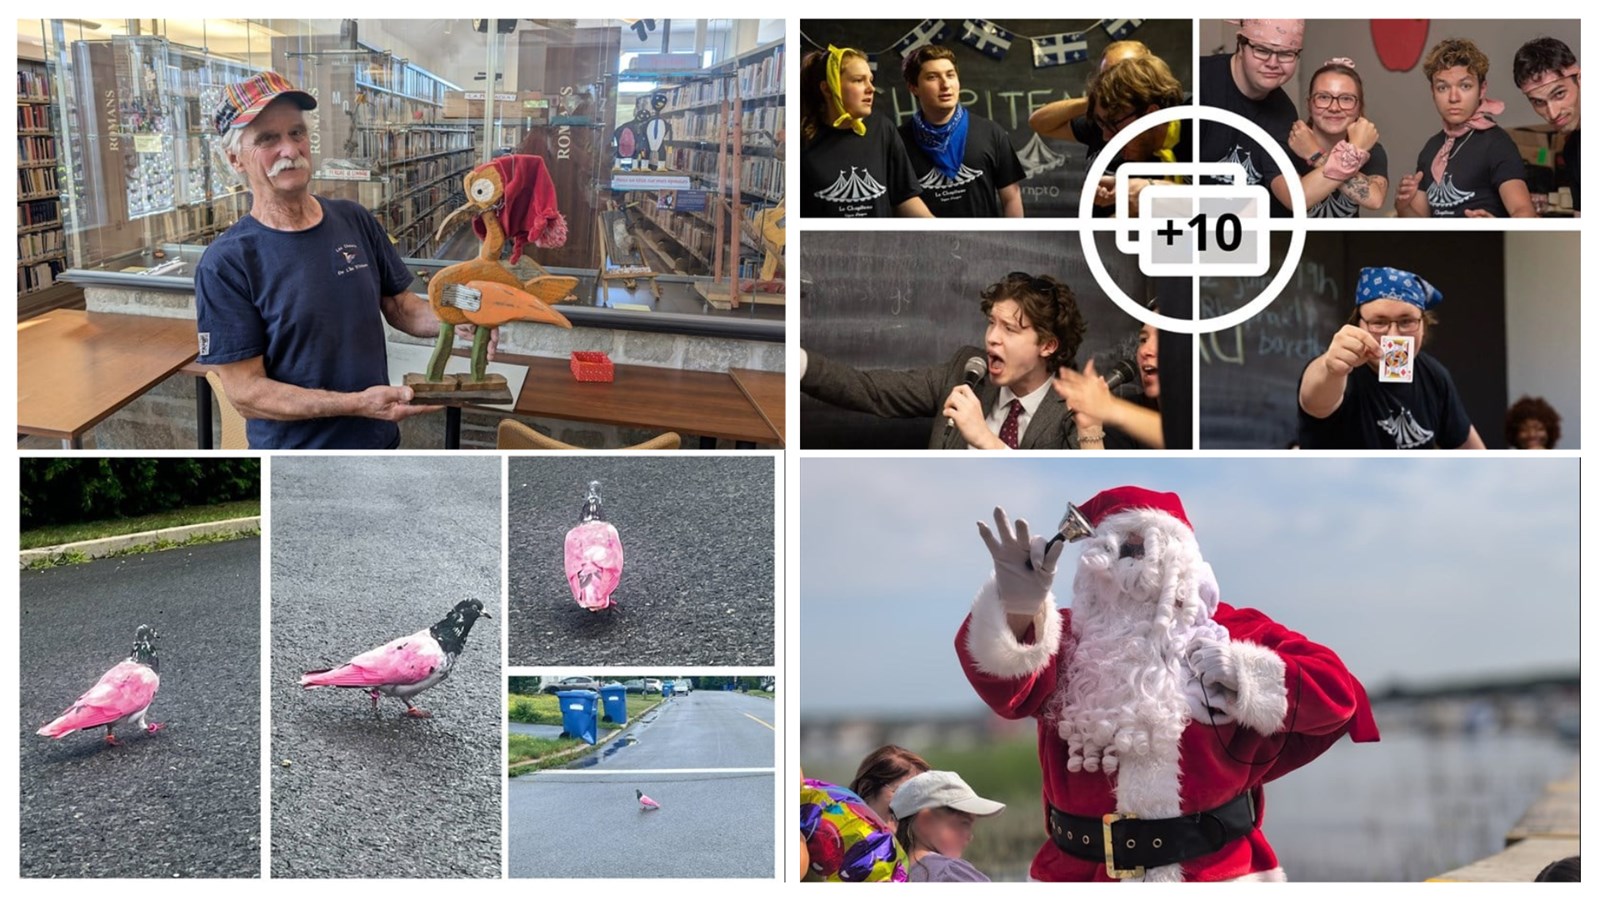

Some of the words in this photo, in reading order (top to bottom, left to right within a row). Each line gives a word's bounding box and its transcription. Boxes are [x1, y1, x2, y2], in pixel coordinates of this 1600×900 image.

[104, 89, 119, 152] ROMANS
[308, 87, 321, 155] ROMAS
[556, 86, 573, 160] ROMAS
[1022, 184, 1061, 202] mpro
